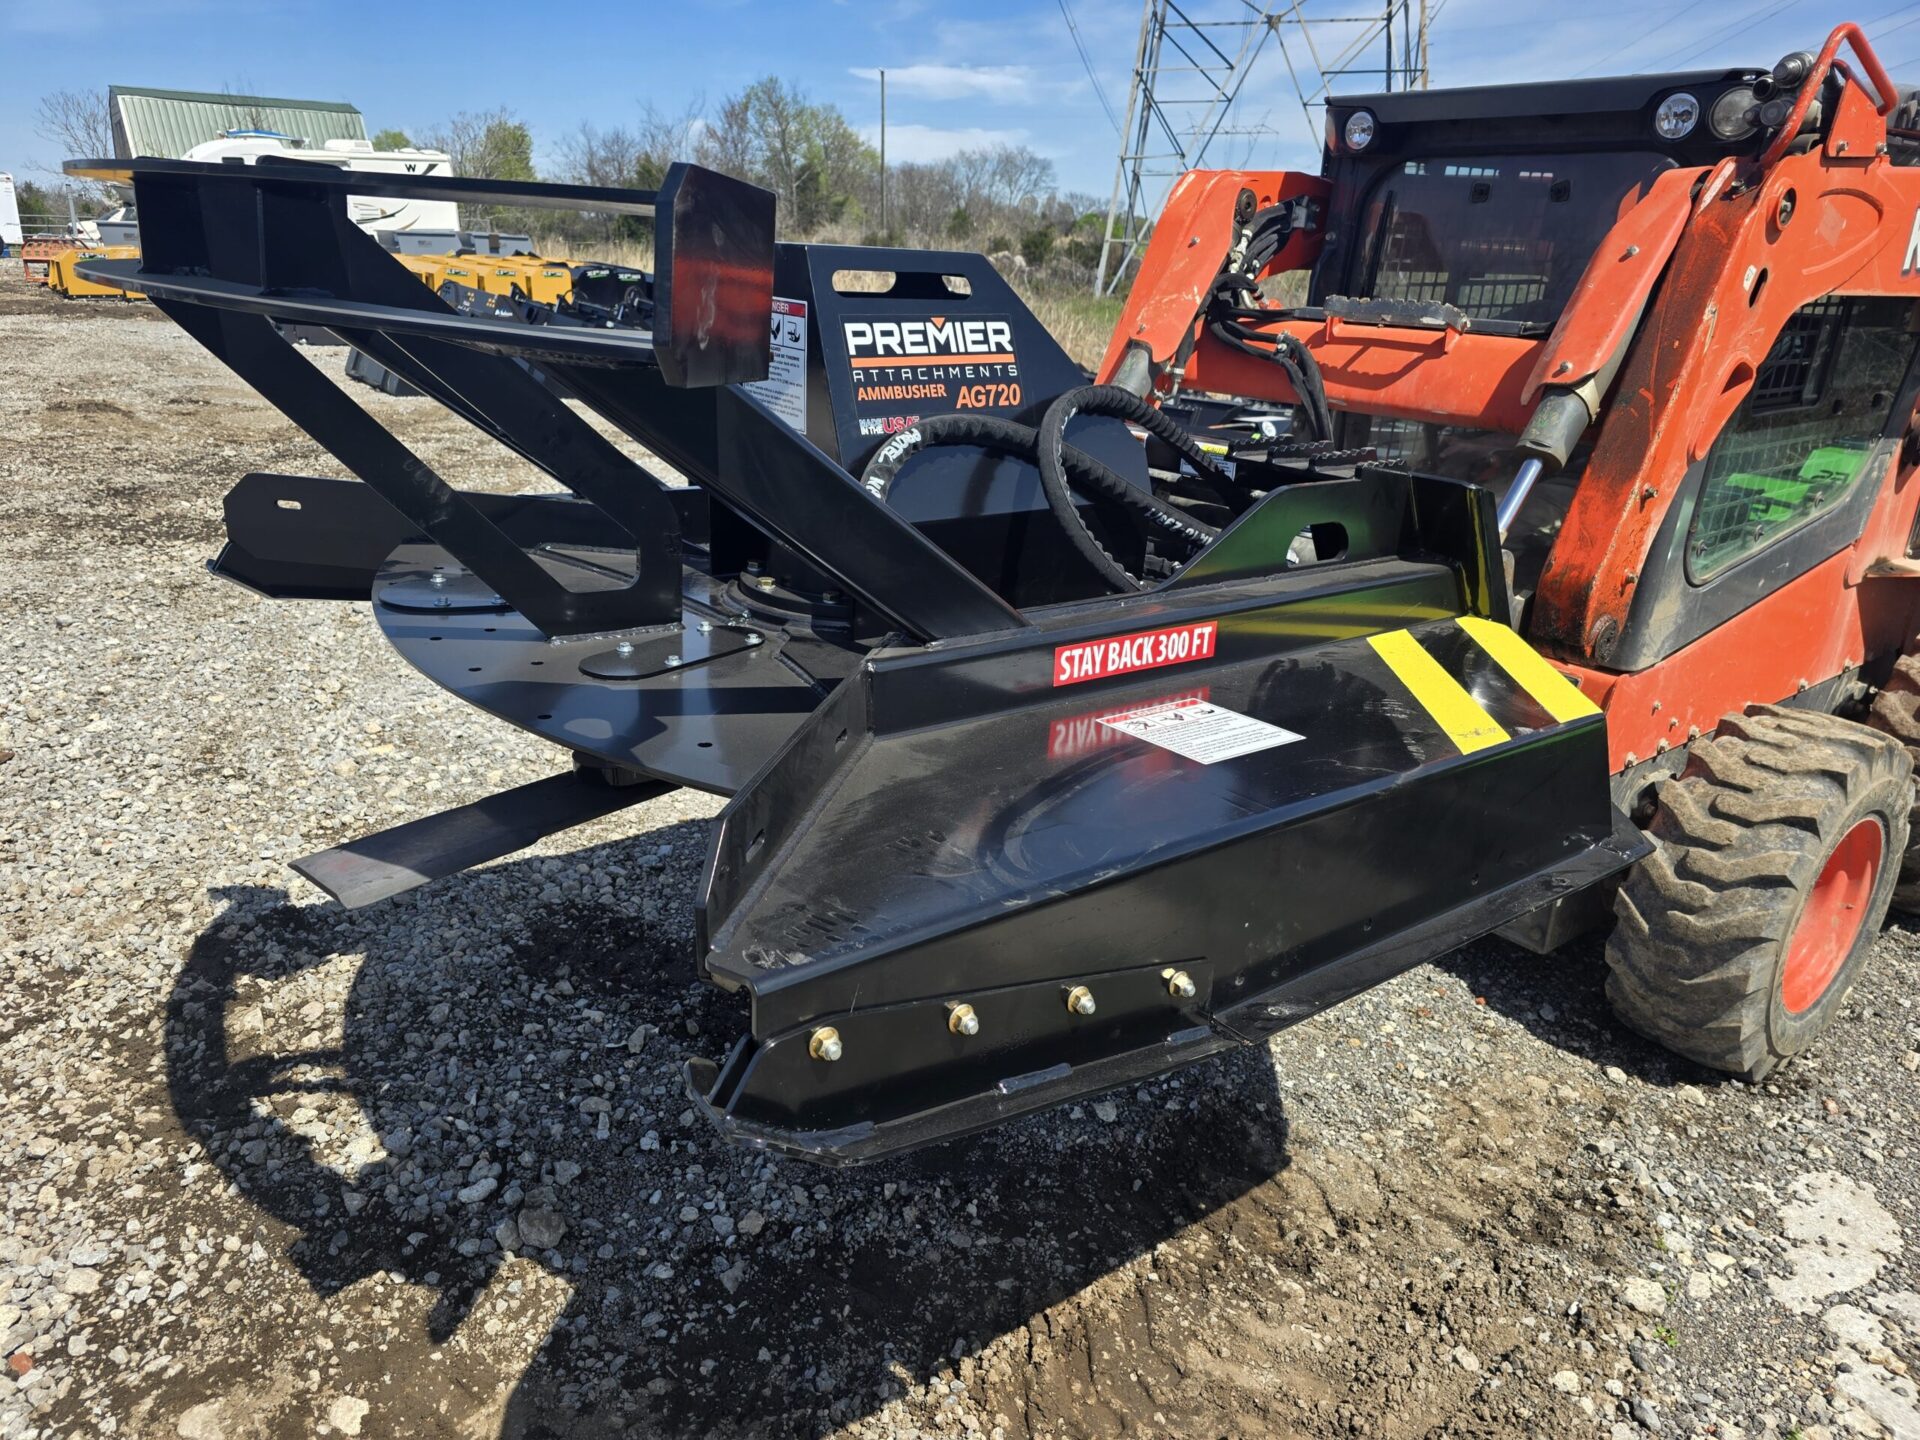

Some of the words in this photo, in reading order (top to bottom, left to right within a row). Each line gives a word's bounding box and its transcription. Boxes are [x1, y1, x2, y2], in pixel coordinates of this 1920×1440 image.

[844, 321, 1014, 355] PREMIER
[852, 364, 1018, 382] ATTACHMENTS
[857, 383, 947, 401] AMMBUSHER
[955, 383, 1021, 409] AG720
[859, 418, 882, 428] MADE
[860, 427, 869, 435] IN
[869, 426, 884, 435] THE
[881, 416, 914, 434] USA
[1060, 644, 1105, 681] STAY
[1106, 635, 1155, 672] BACK
[1156, 630, 1190, 662] 300
[1191, 626, 1212, 657] FT
